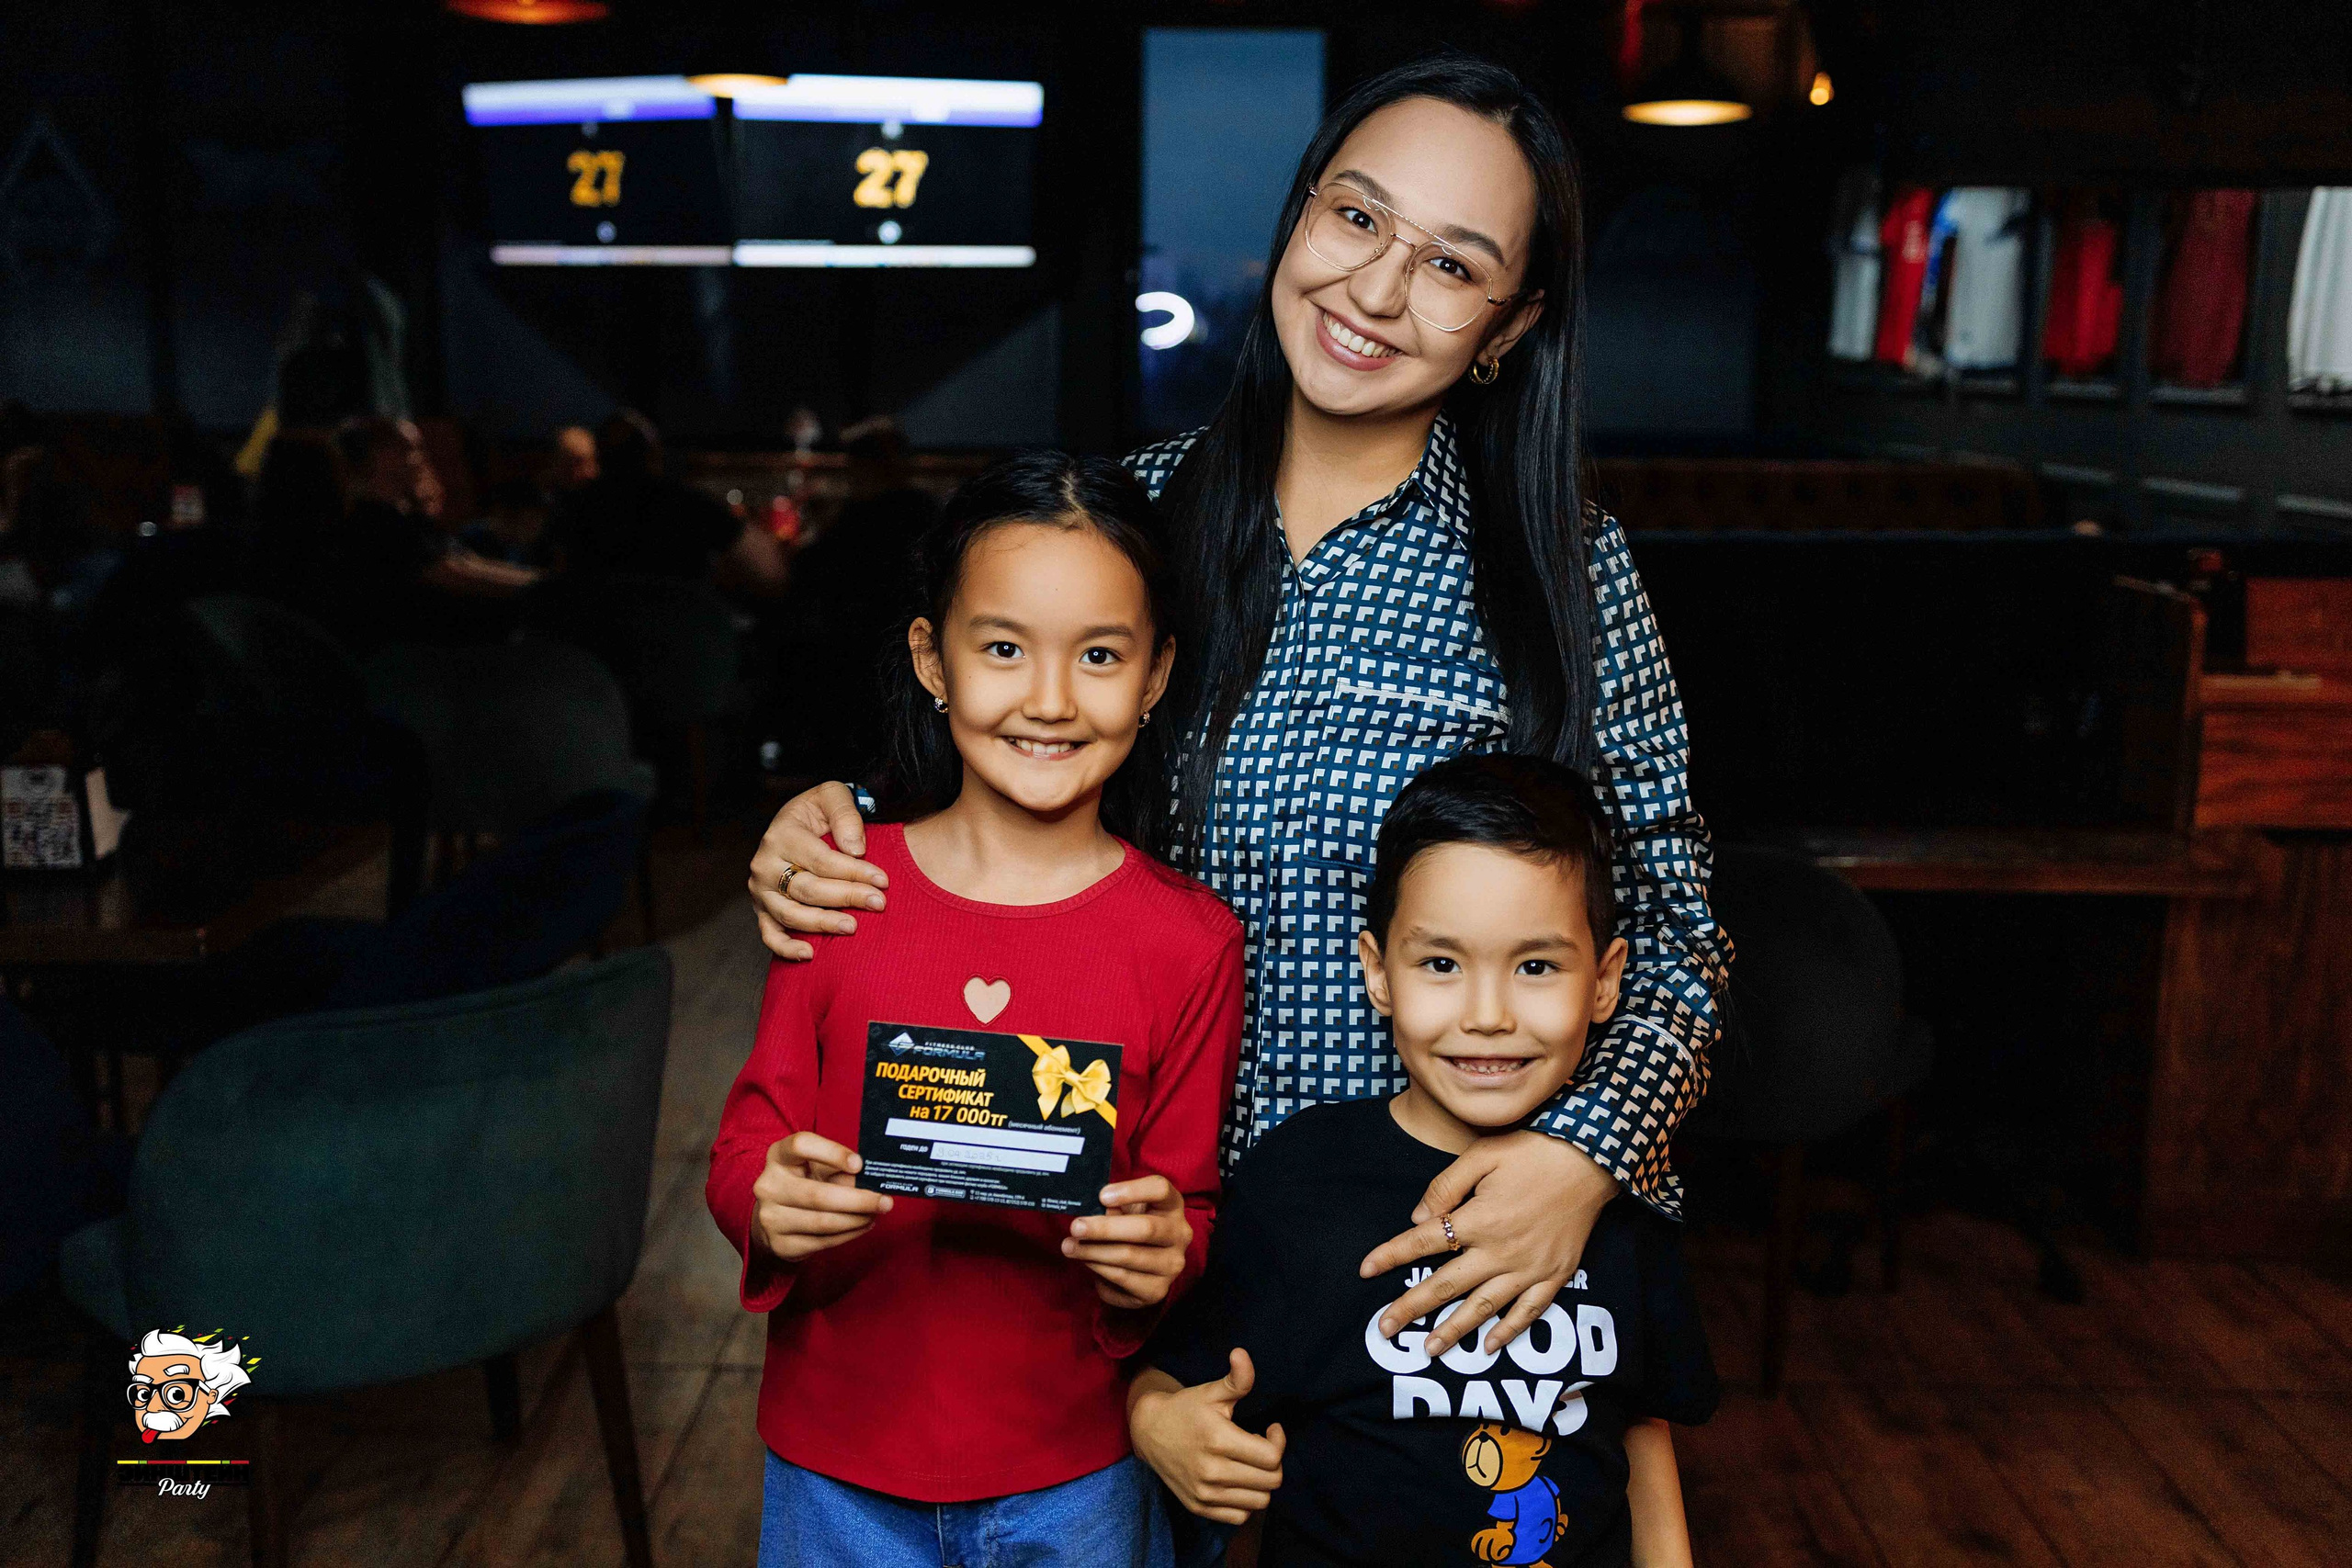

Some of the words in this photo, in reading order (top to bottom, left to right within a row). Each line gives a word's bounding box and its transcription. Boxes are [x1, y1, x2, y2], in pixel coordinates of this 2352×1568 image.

[567, 150, 626, 208] 27
[854, 148, 929, 209] 27
[913, 1046, 986, 1060] FORMULA
[876, 1061, 986, 1088] ПОДАРОЧНЫЙ
[898, 1084, 994, 1108] СЕРТИФИКАТ
[910, 1104, 928, 1120] на
[933, 1105, 951, 1122] 17
[879, 1182, 920, 1193] FORMULA
[1365, 1299, 1617, 1375] GOOD
